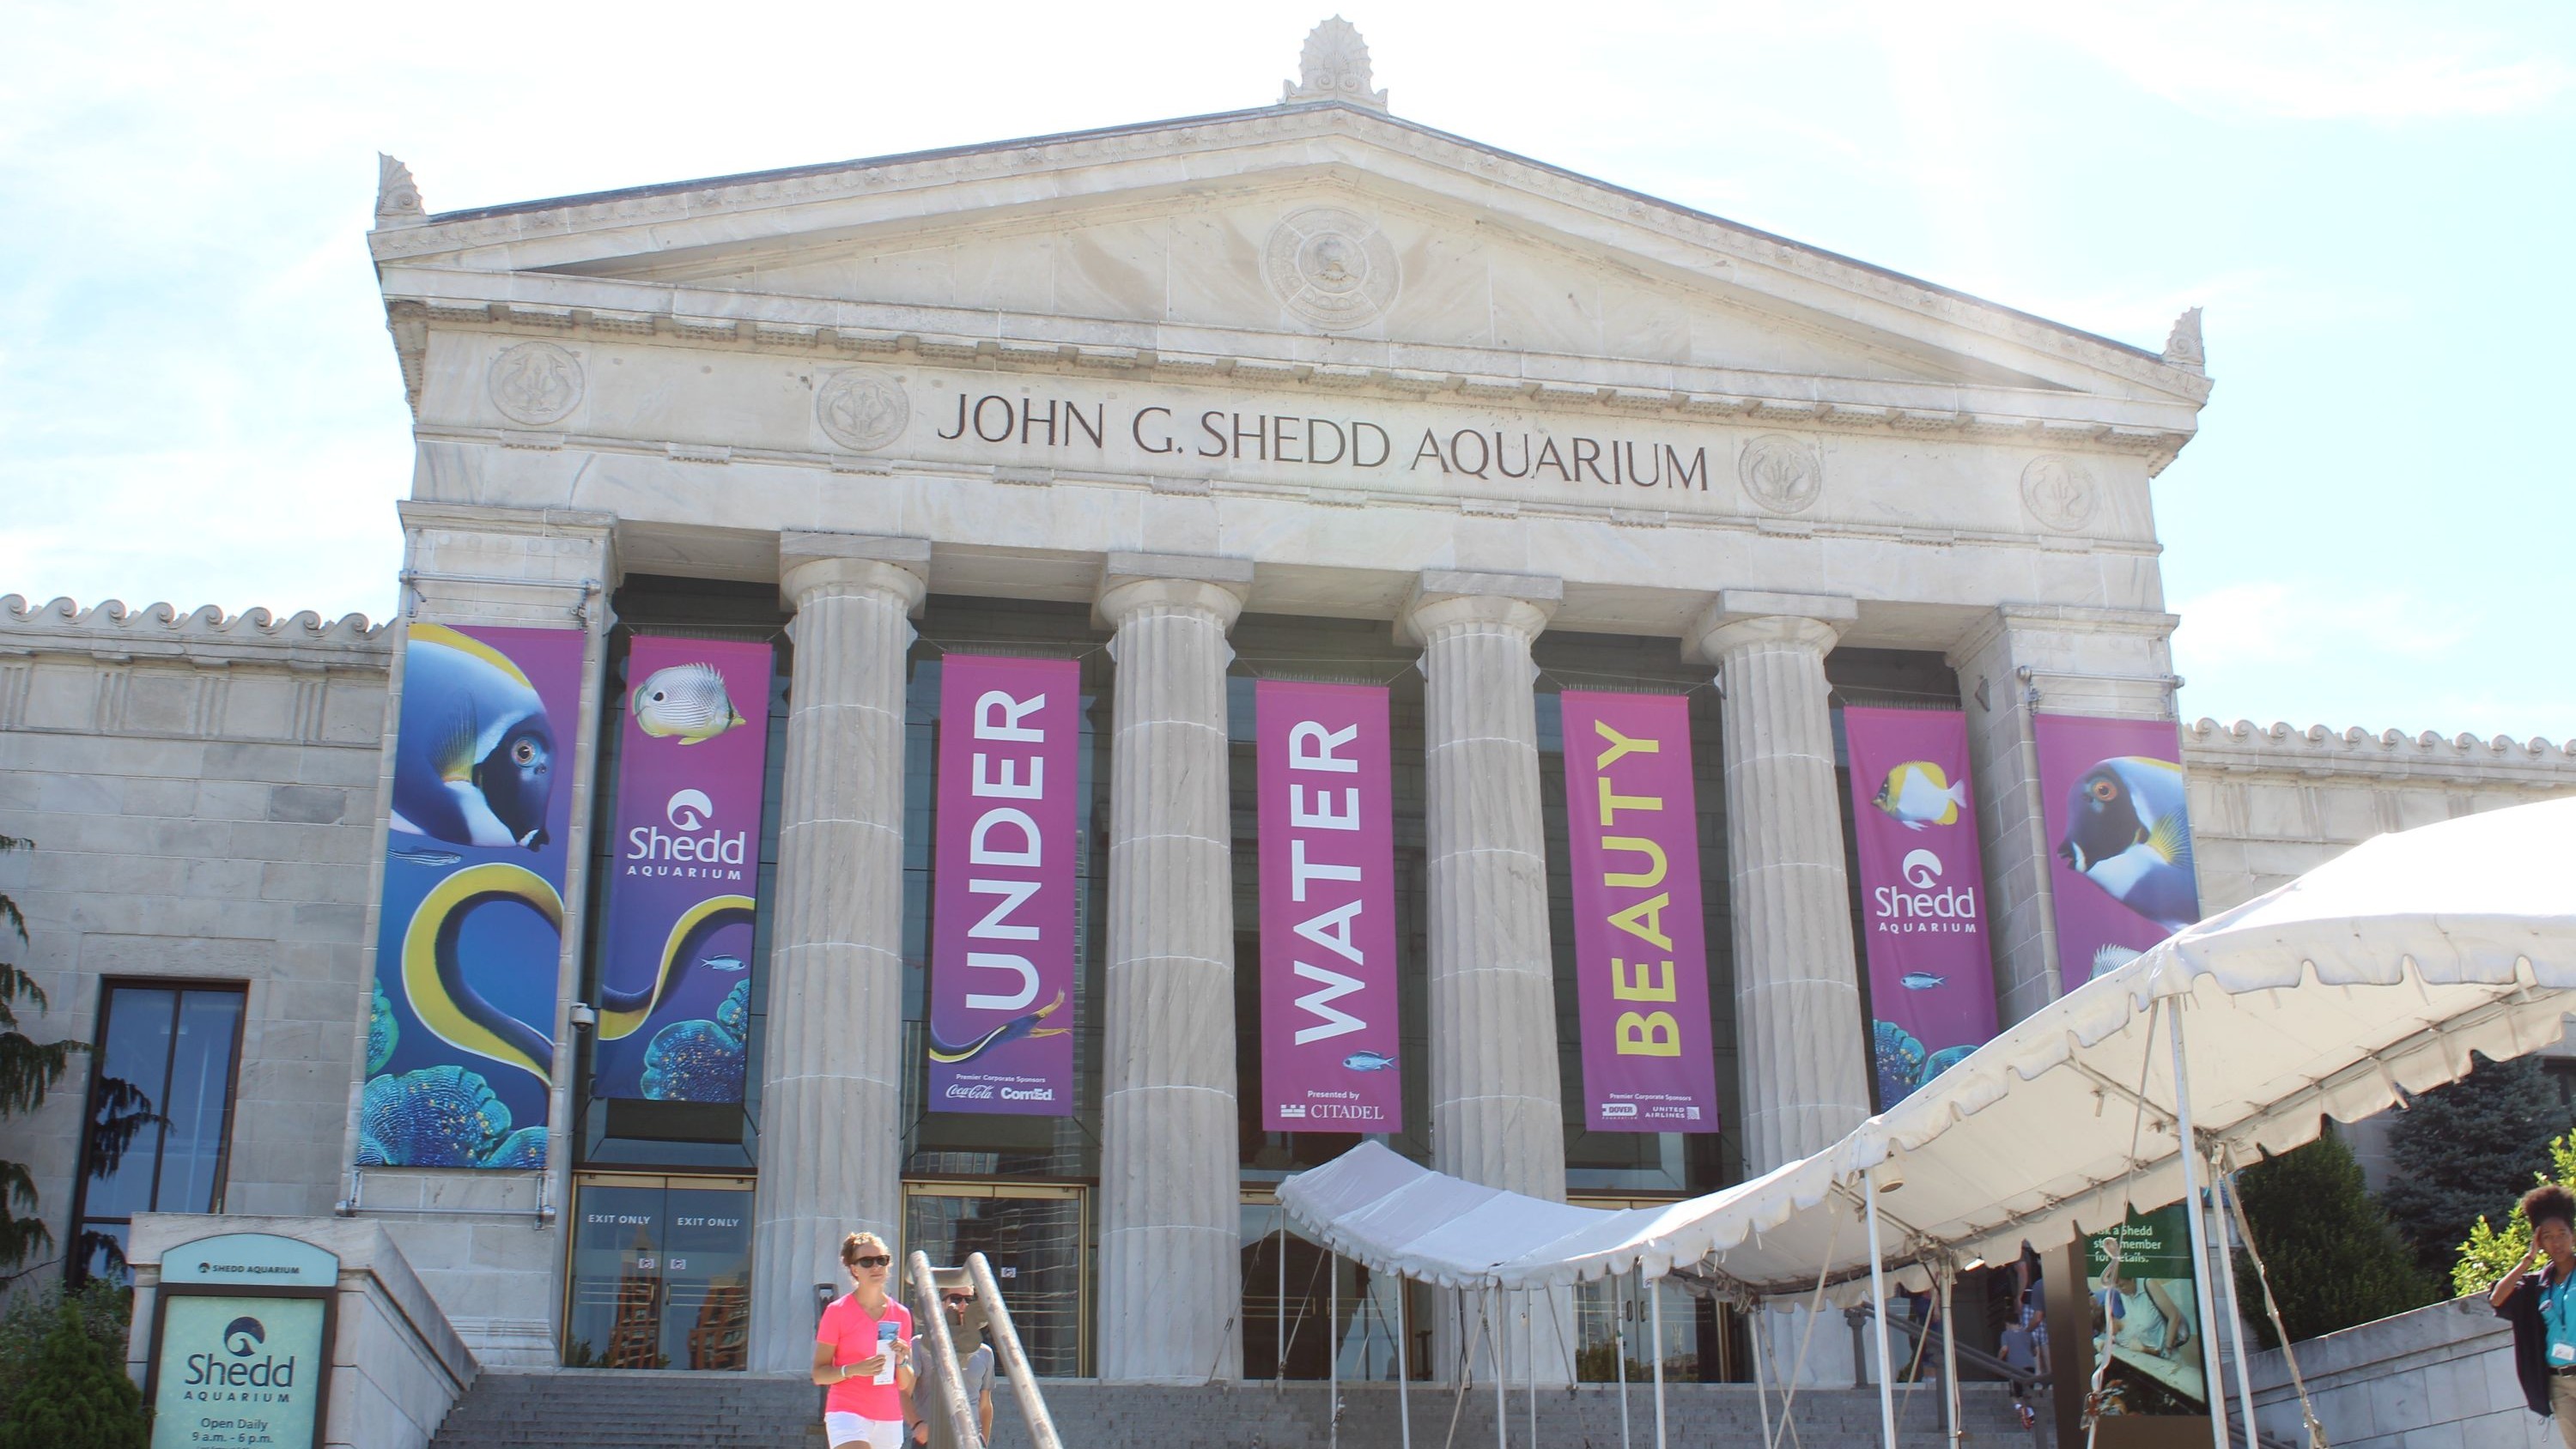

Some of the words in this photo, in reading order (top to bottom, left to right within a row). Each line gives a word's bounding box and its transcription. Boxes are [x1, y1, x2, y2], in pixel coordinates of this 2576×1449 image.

[937, 393, 1103, 448] JOHN
[1133, 406, 1183, 454] G.
[1198, 410, 1390, 468] SHEDD
[1410, 427, 1708, 491] AQUARIUM
[627, 826, 746, 864] Shedd
[965, 689, 1046, 1011] UNDER
[627, 865, 741, 880] AQUARIUM
[1288, 720, 1367, 1046] WATER
[1594, 718, 1681, 1058] BEAUTY
[1874, 886, 1976, 918] Shedd
[1879, 922, 1977, 934] AQUARIUM
[1000, 1087, 1053, 1100] ComEd
[1307, 1090, 1347, 1099] Presented
[1349, 1091, 1360, 1100] by
[1310, 1104, 1384, 1119] CITADEL
[587, 1214, 616, 1223] EXIT
[618, 1215, 651, 1225] ONLY
[677, 1217, 705, 1226] EXIT
[708, 1218, 740, 1227] ONLY
[2112, 1227, 2119, 1235] a
[2120, 1239, 2161, 1250] member
[2095, 1251, 2109, 1262] for
[2117, 1252, 2149, 1263] etails.
[212, 1264, 245, 1273] SHEDD
[246, 1265, 300, 1274] AQUARIUM
[185, 1353, 295, 1387] Shedd
[184, 1391, 289, 1403] AQUARIUM
[201, 1417, 234, 1430] Open
[237, 1419, 268, 1432] Daily
[191, 1432, 199, 1441] 9
[202, 1434, 228, 1442] a.m.
[239, 1433, 246, 1443] 6
[248, 1435, 274, 1445] p.m.
